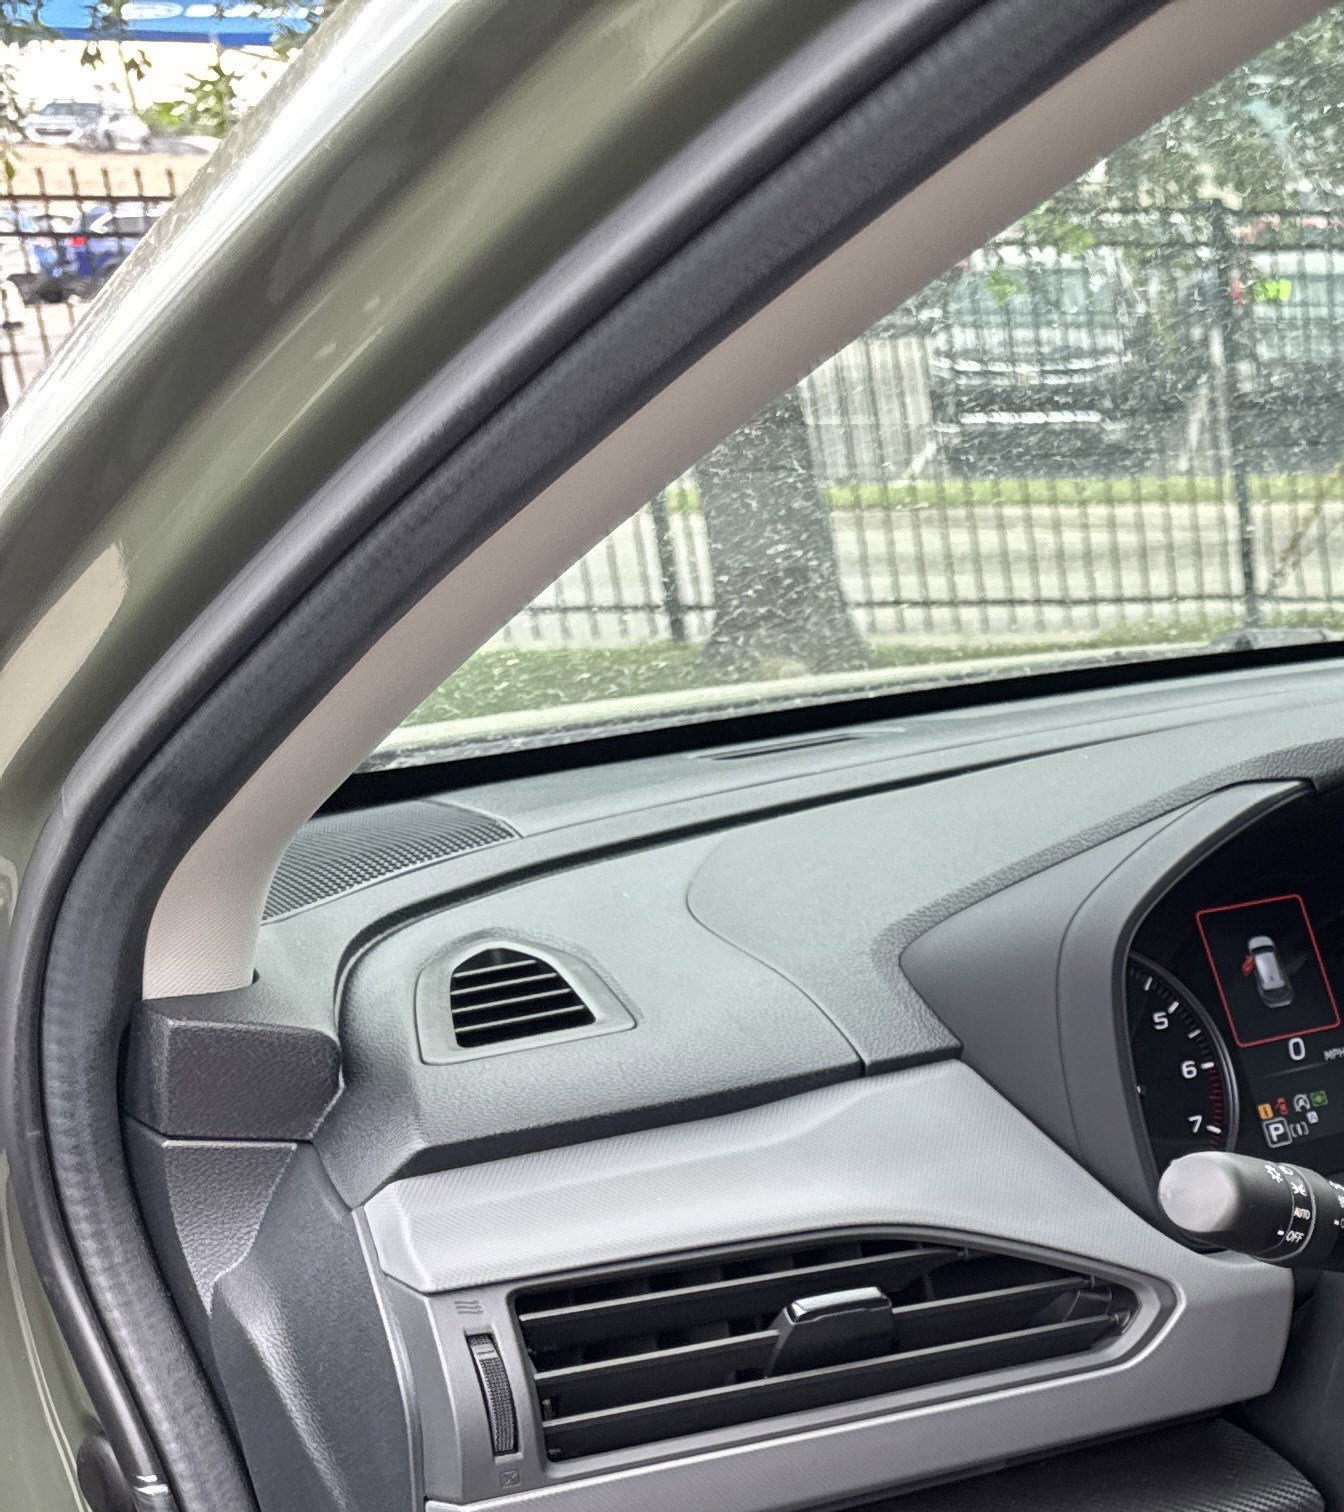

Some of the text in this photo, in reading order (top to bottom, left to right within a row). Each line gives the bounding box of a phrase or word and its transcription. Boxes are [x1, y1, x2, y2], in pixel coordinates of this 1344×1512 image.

[1151, 1012, 1169, 1030] 5
[1288, 1037, 1306, 1061] 0
[1181, 1060, 1198, 1079] 6
[1188, 1115, 1203, 1134] 7
[1267, 1123, 1284, 1143] P
